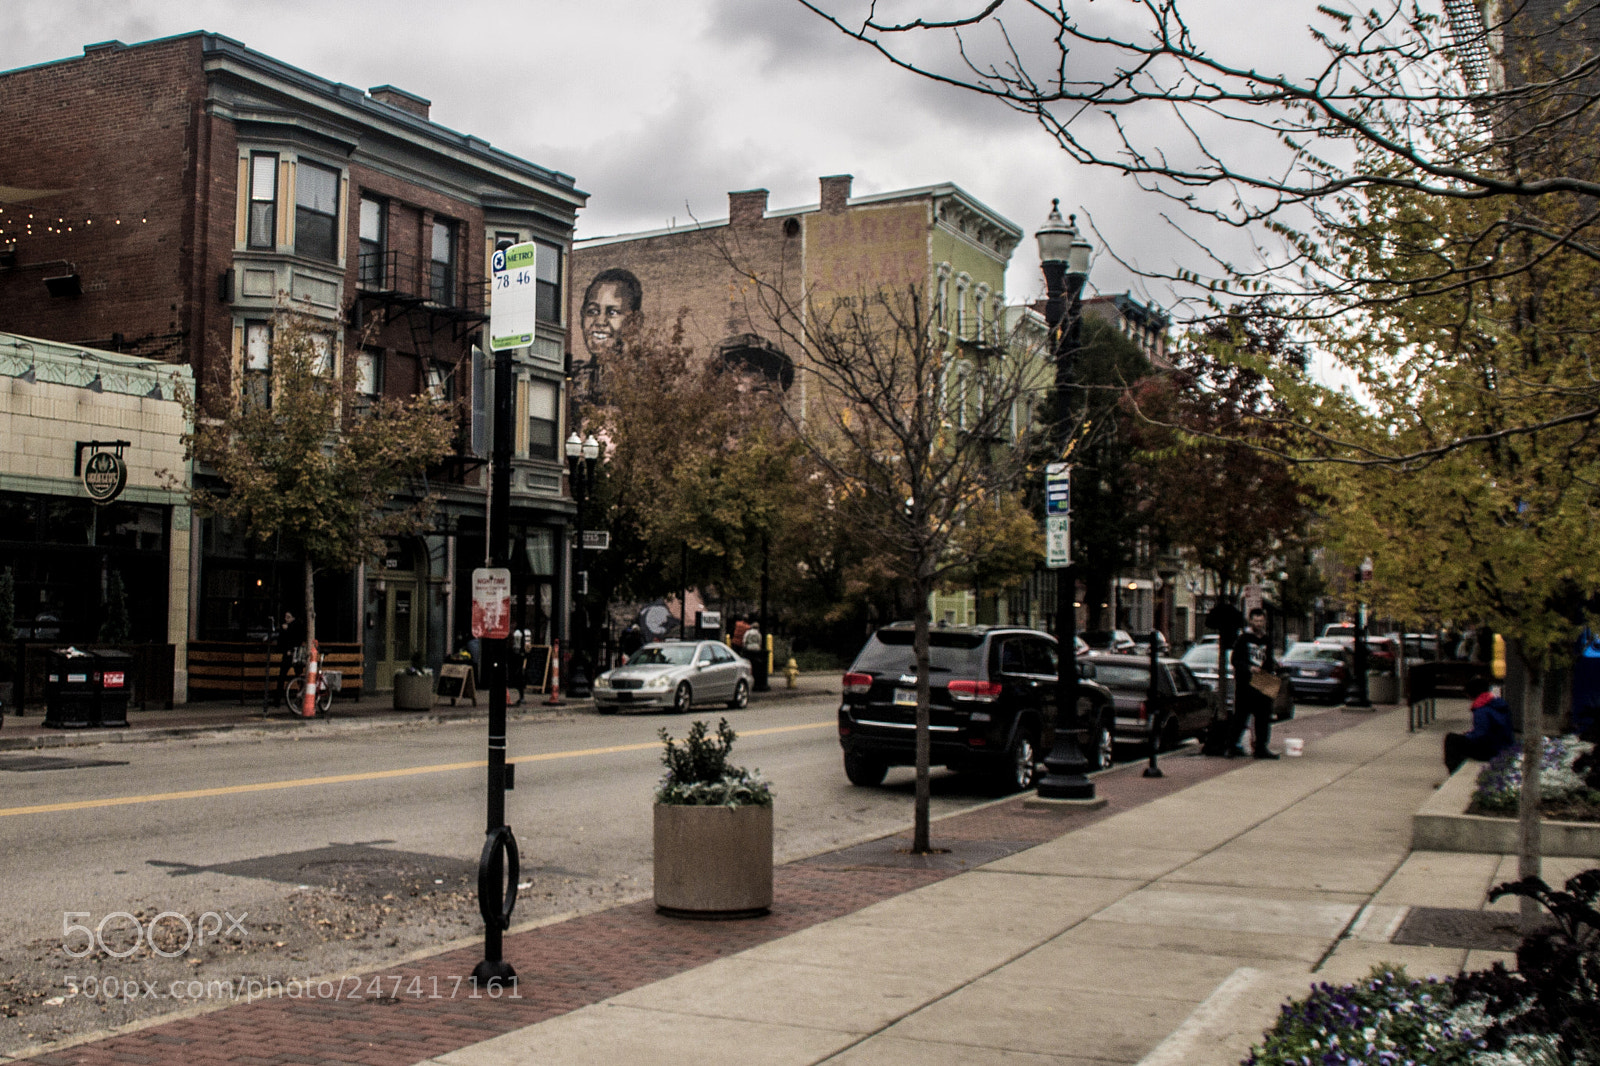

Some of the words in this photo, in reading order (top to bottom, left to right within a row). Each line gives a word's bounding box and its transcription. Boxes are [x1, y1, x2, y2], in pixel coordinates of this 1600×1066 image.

[507, 251, 534, 262] METRO
[497, 274, 510, 290] 78
[516, 270, 531, 285] 46
